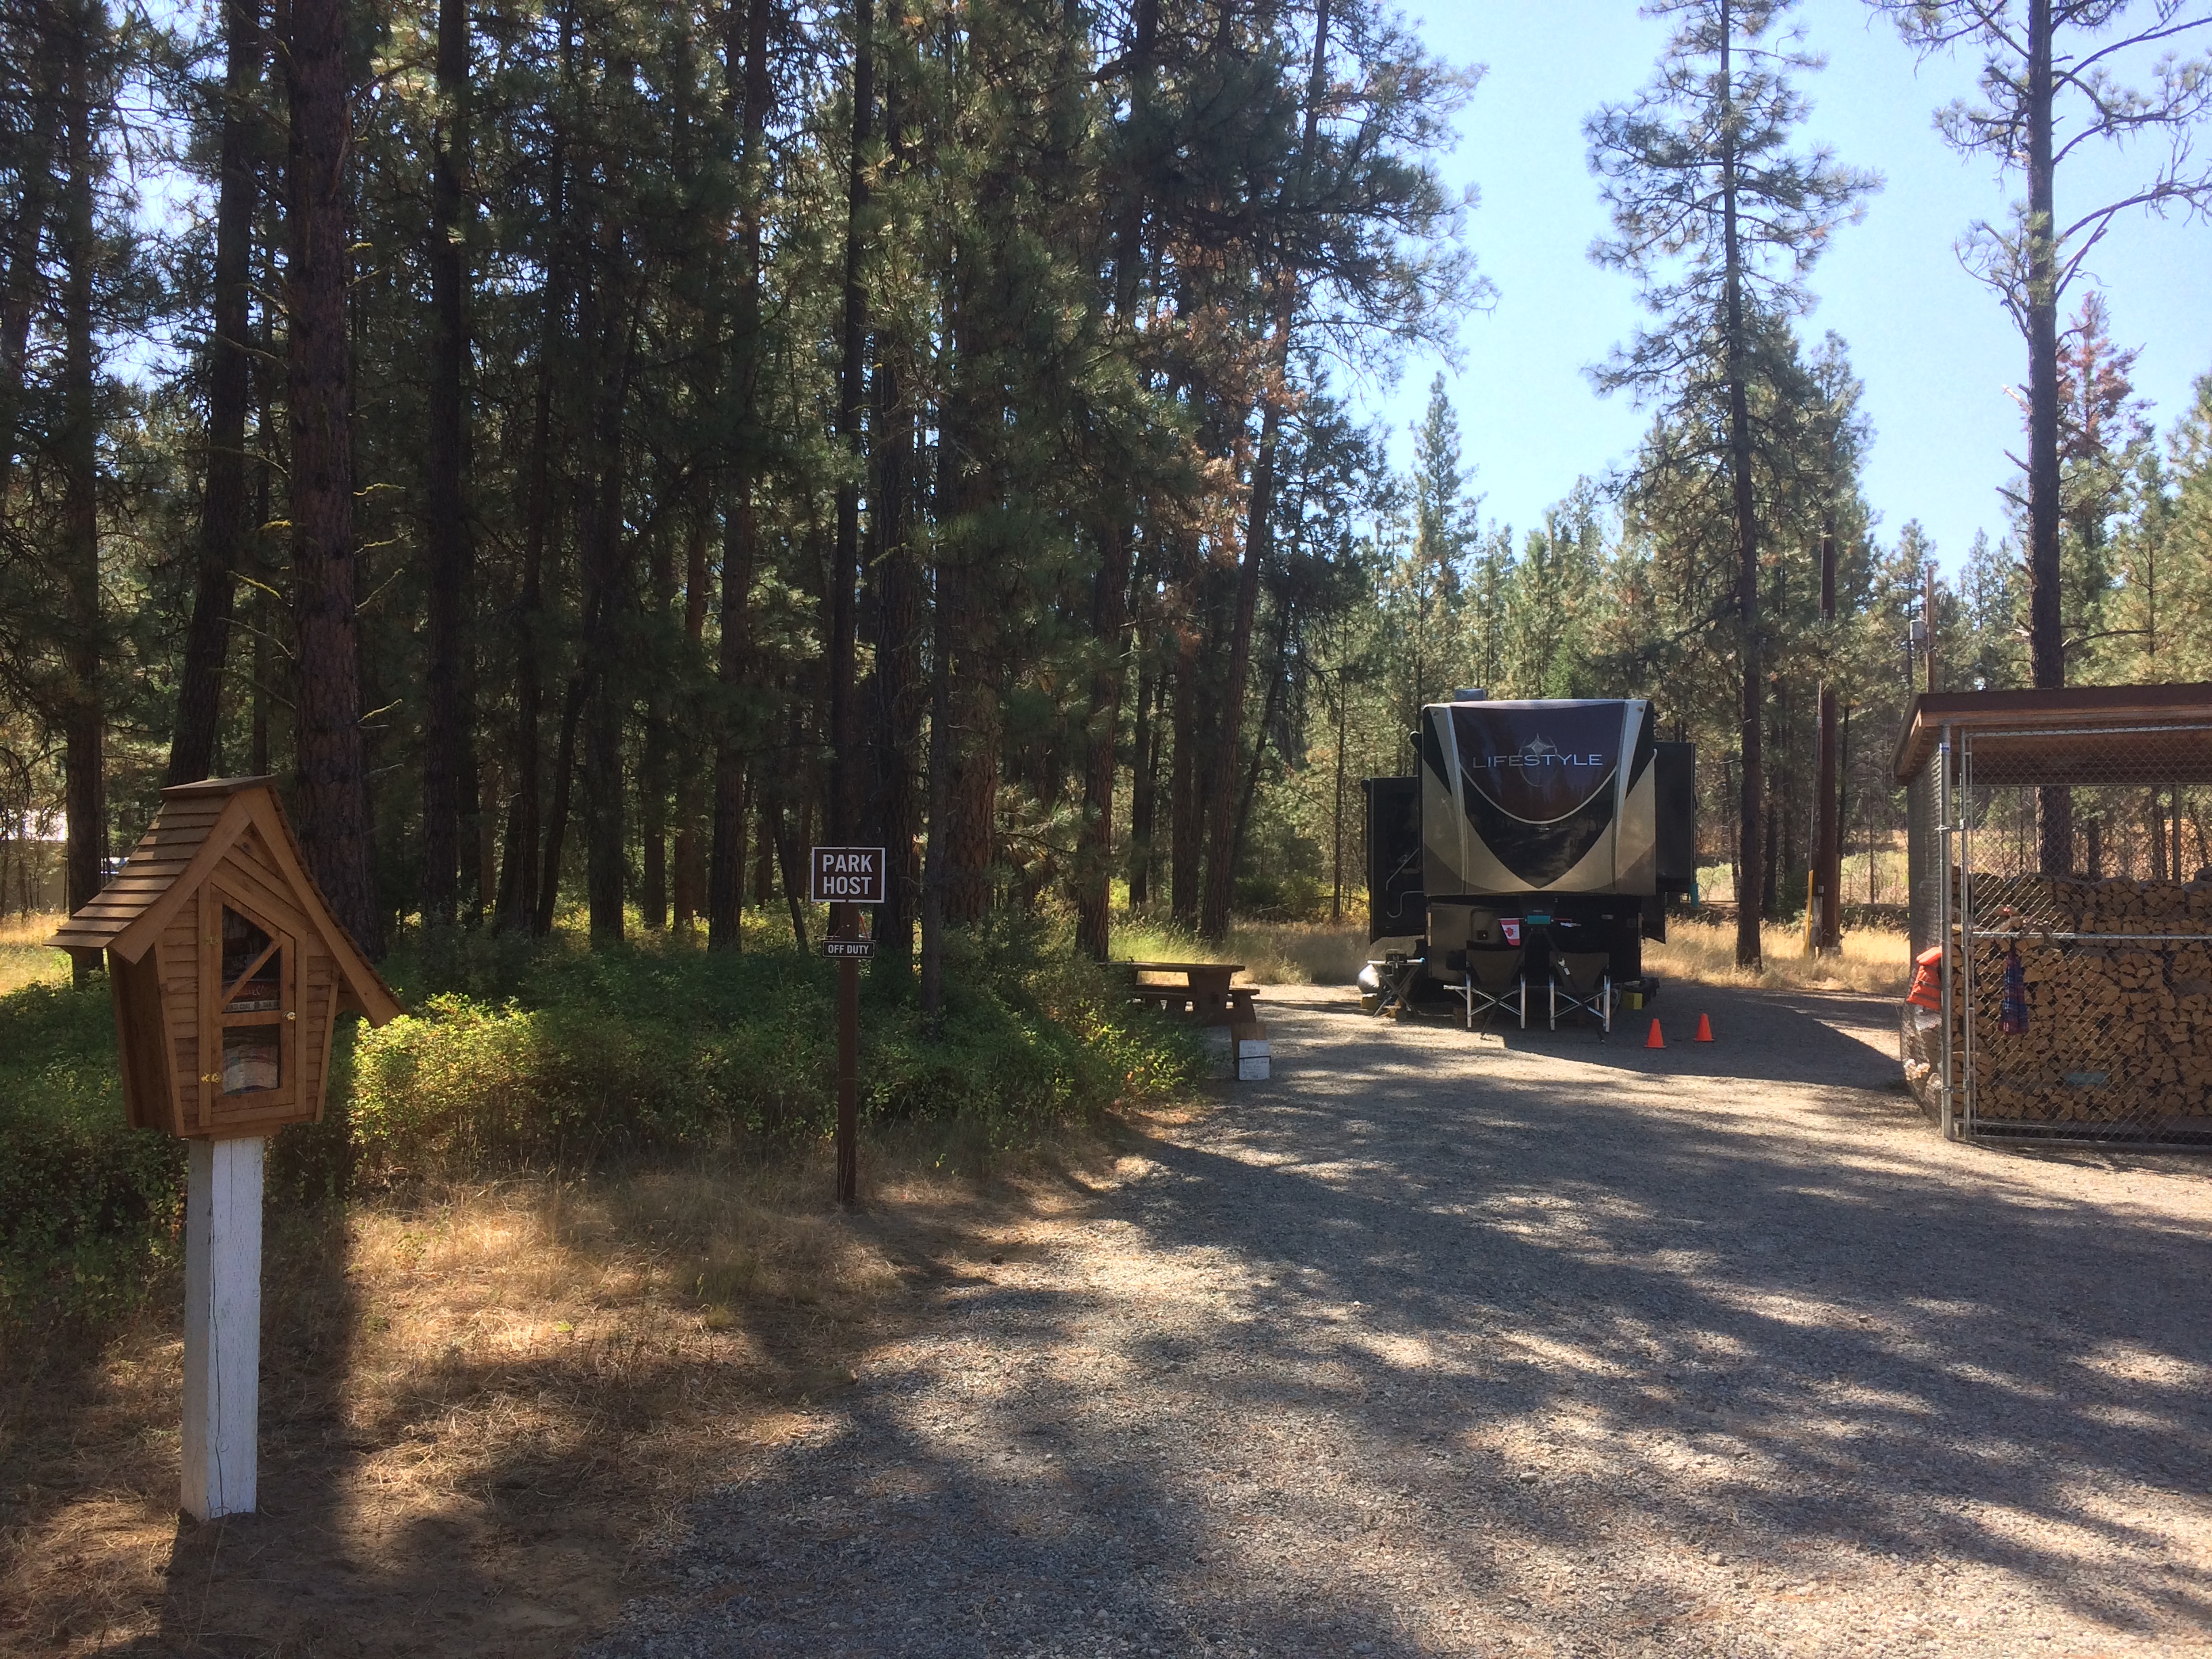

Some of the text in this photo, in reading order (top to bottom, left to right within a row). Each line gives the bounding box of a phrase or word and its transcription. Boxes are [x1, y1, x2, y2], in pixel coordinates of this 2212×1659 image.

[1473, 754, 1603, 769] LIFESTYLE
[823, 854, 873, 872] PARK
[823, 876, 872, 895] HOST
[827, 944, 869, 954] OFF DUTY
